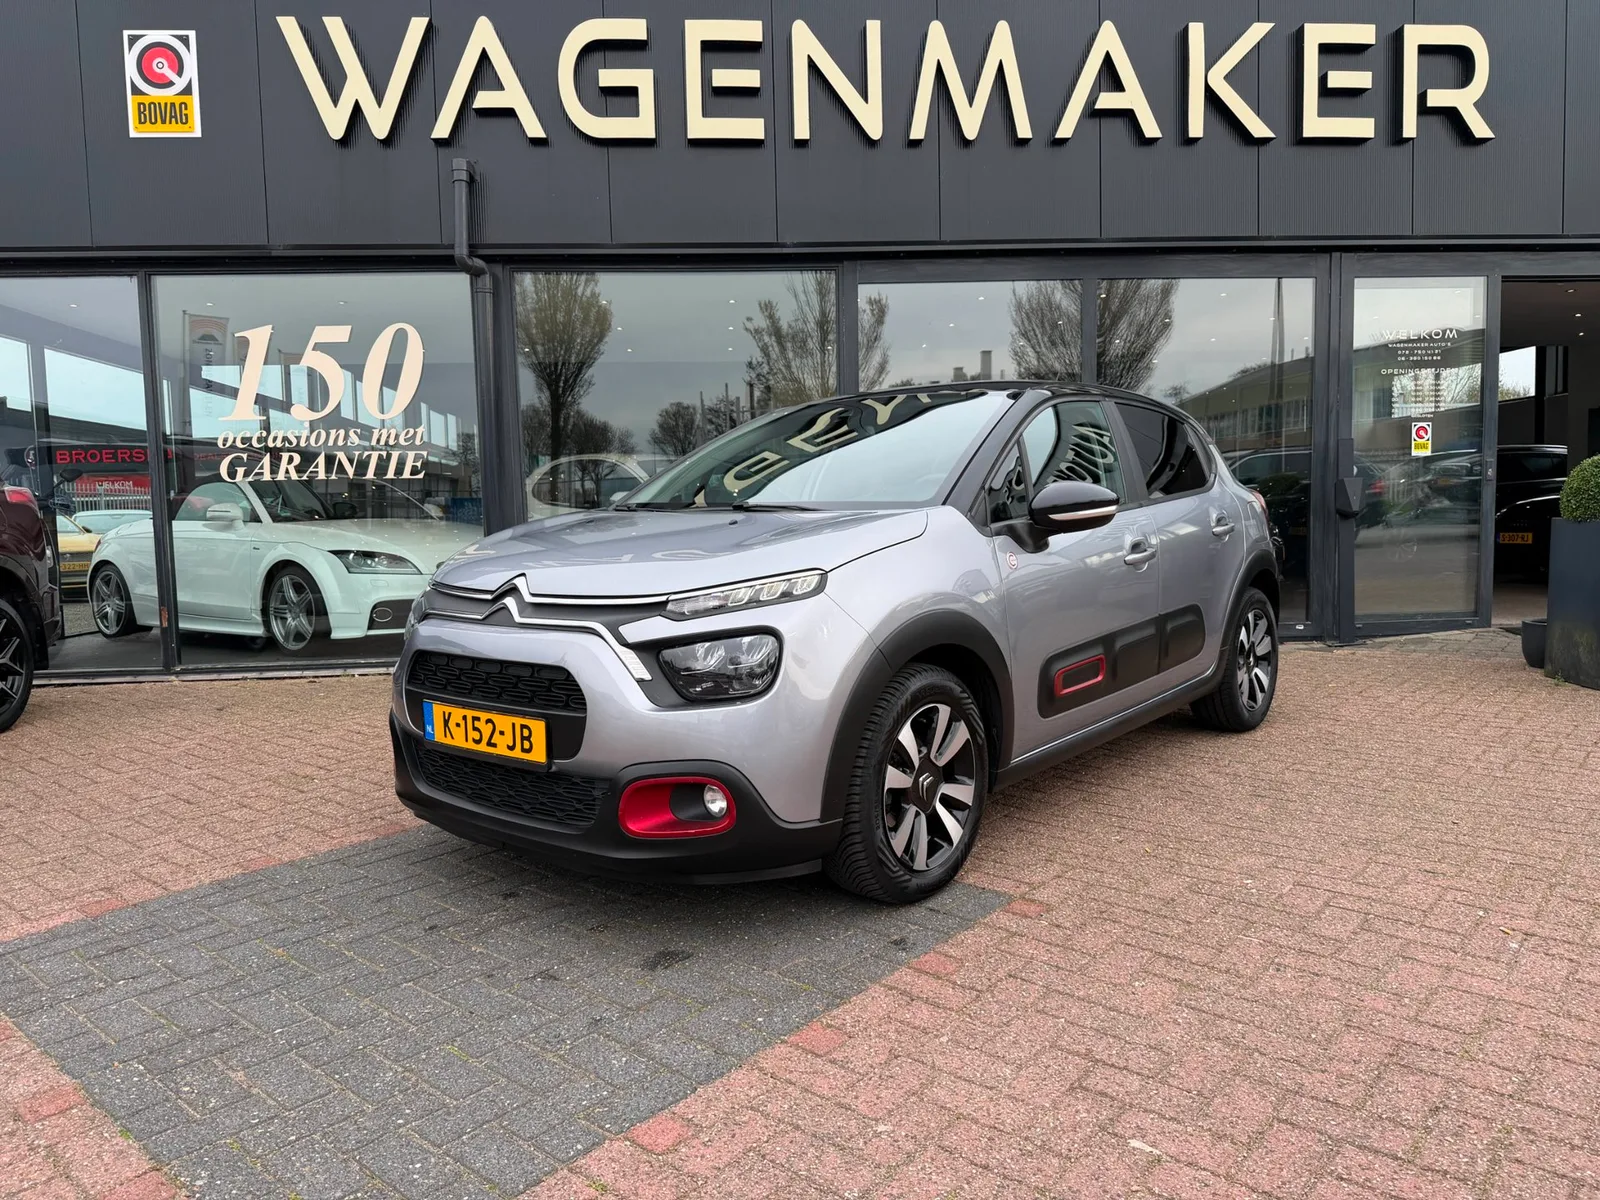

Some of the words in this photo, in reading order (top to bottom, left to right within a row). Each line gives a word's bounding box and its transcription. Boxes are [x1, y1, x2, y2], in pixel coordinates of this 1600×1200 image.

[275, 15, 1496, 142] WAGENMAKER
[136, 101, 190, 126] BOVAG
[1382, 329, 1458, 340] WELKOM
[218, 322, 425, 421] 150
[217, 421, 361, 449] occasions
[371, 423, 426, 446] met
[219, 450, 428, 483] GARANTIE
[426, 724, 434, 734] NL
[442, 710, 533, 754] K-152-JB
